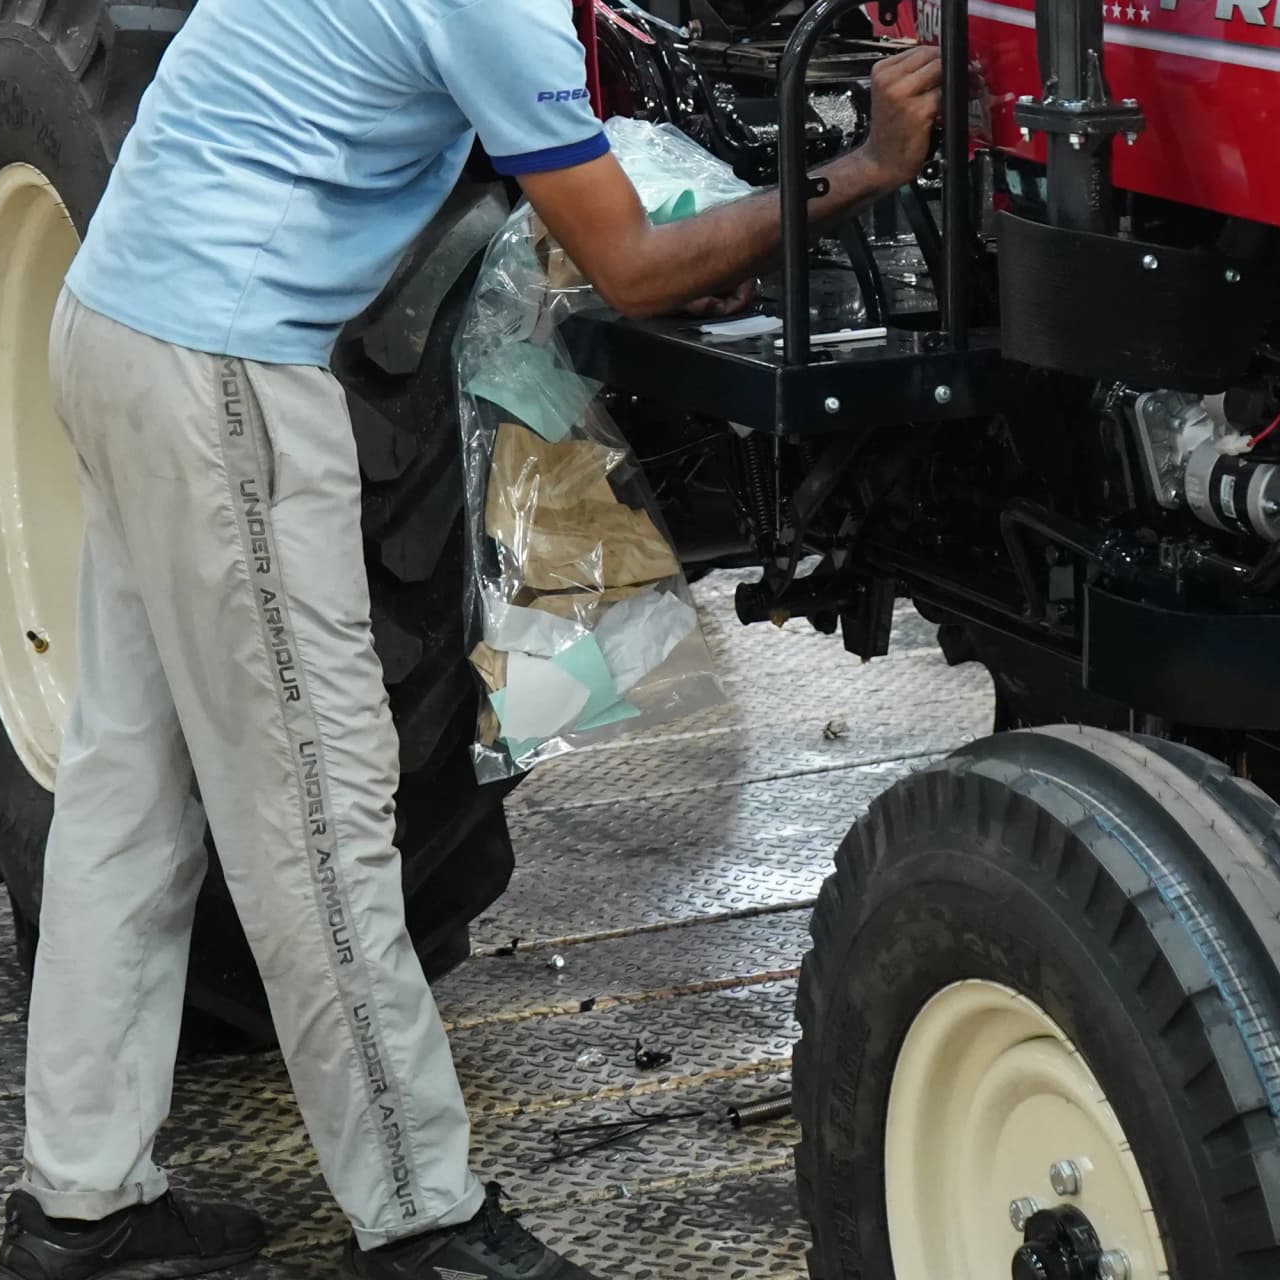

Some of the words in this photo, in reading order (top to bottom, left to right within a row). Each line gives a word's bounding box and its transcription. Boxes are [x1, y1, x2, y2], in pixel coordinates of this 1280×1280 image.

[239, 478, 272, 574] UNDER
[259, 587, 301, 704] ARMOUR
[298, 739, 328, 837] UNDER
[315, 847, 355, 967] ARMOUR
[352, 1002, 388, 1097] UNDER
[378, 1103, 418, 1222] ARMOUR
